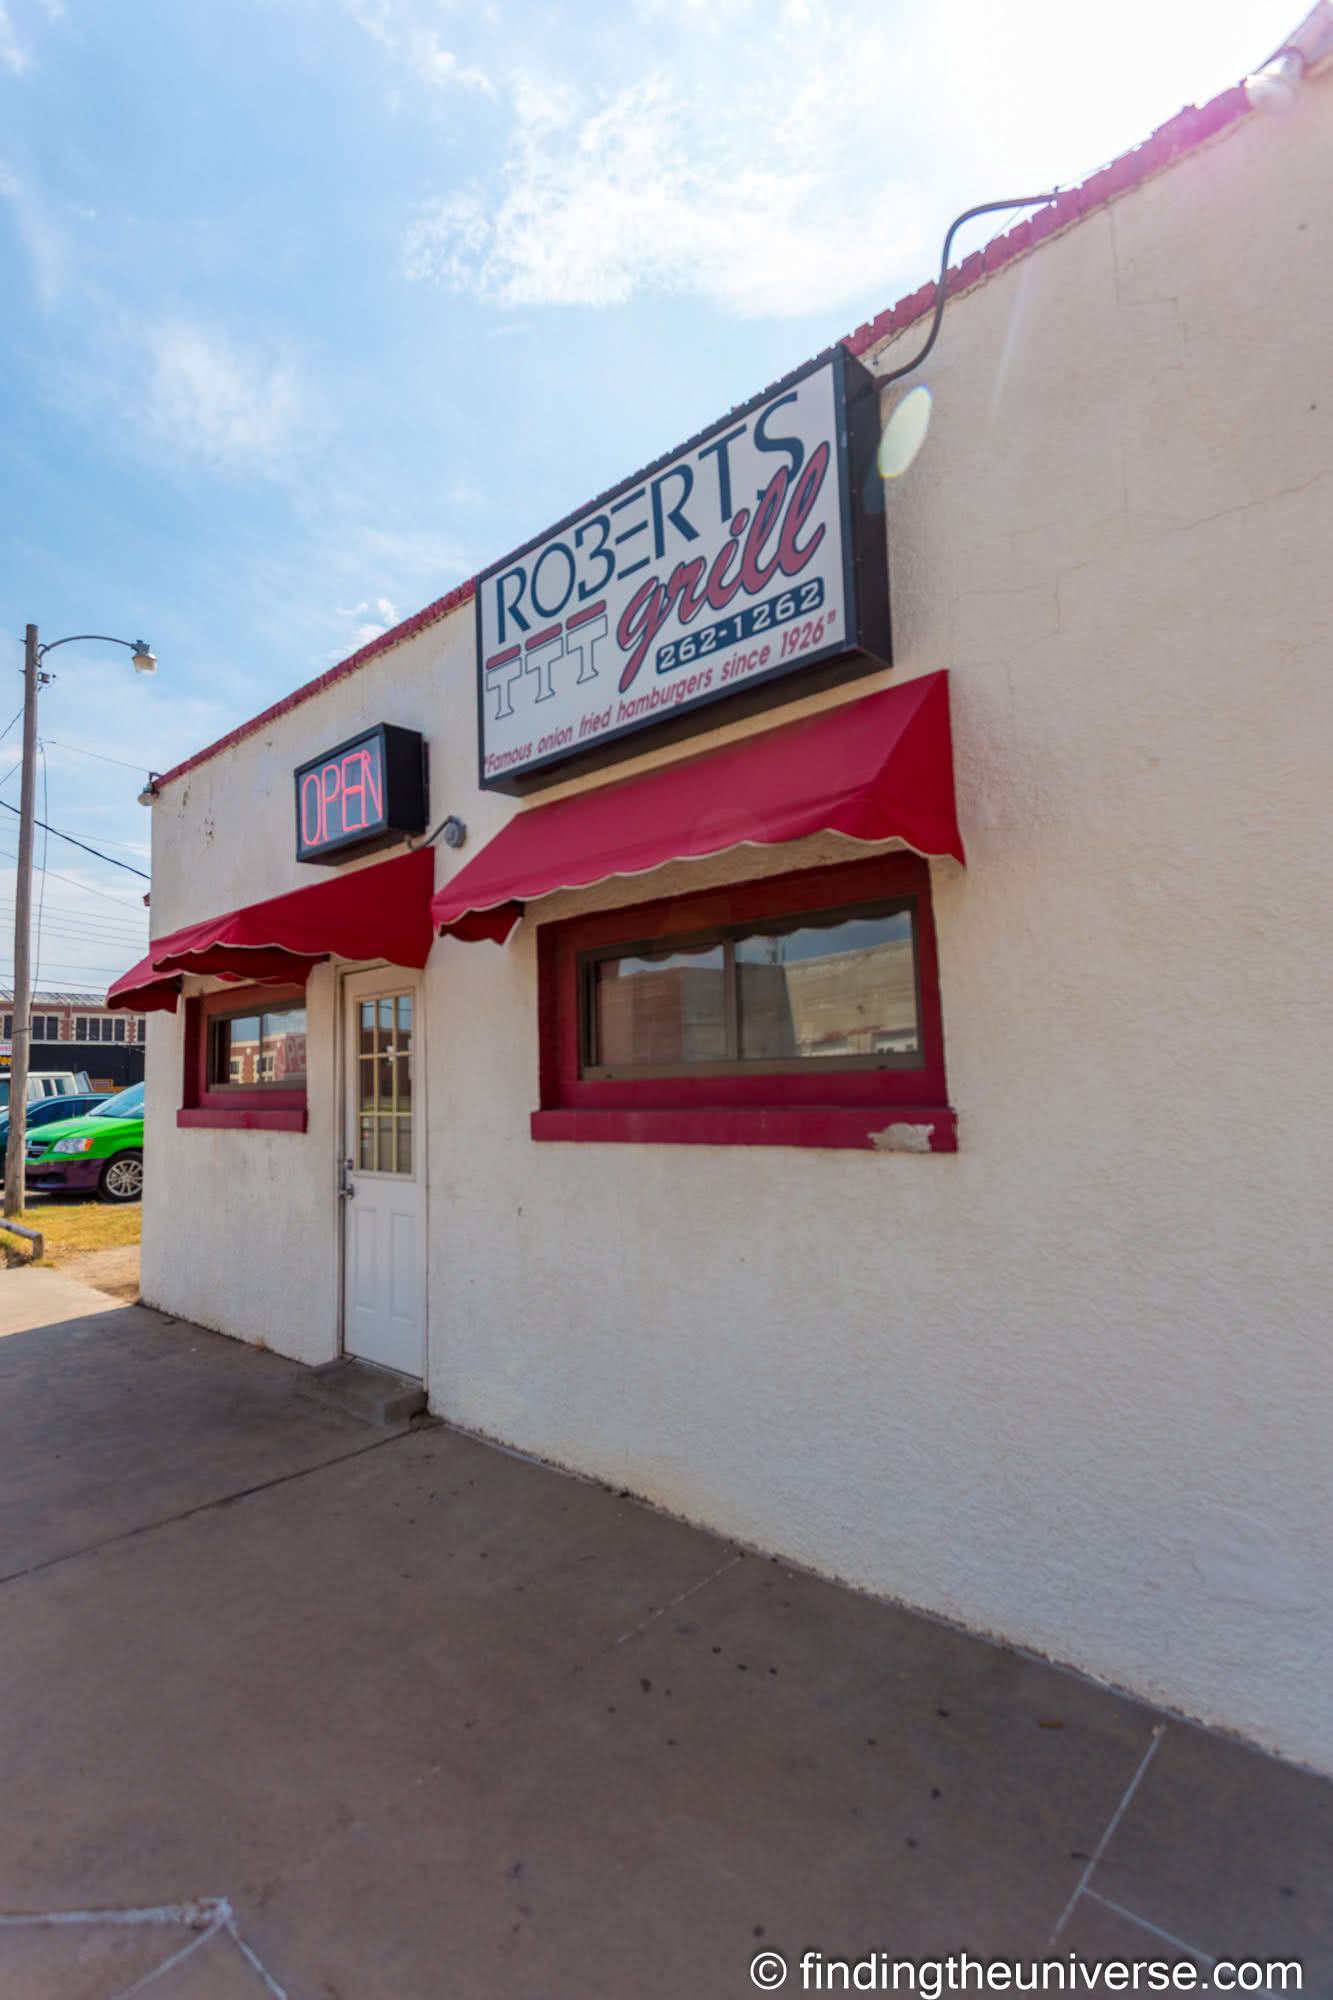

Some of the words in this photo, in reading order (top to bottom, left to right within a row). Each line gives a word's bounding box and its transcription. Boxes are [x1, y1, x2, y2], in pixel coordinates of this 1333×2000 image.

[497, 391, 805, 644] ROBERTS
[616, 440, 830, 693] grill
[537, 725, 573, 753] onion
[578, 704, 612, 738] fried
[616, 668, 713, 722] hamburgers
[720, 645, 771, 681] since
[780, 608, 837, 658] 1926"
[659, 580, 821, 670] 262-1262
[302, 749, 383, 846] OPEN
